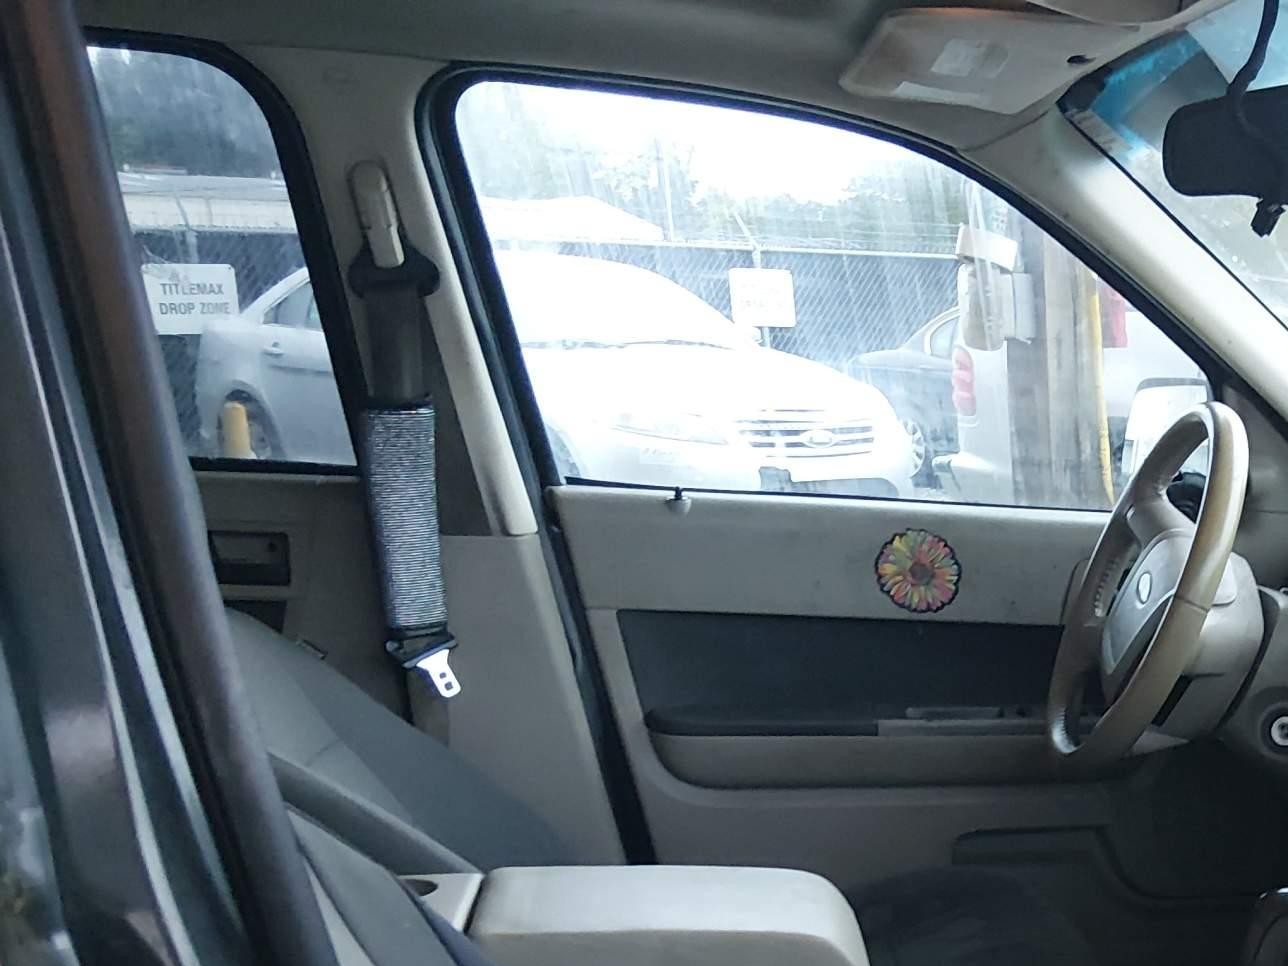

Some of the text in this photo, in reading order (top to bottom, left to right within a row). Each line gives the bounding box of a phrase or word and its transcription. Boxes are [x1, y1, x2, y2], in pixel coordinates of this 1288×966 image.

[160, 282, 224, 296] TITLEMAX
[159, 302, 231, 315] DROP ZONE
